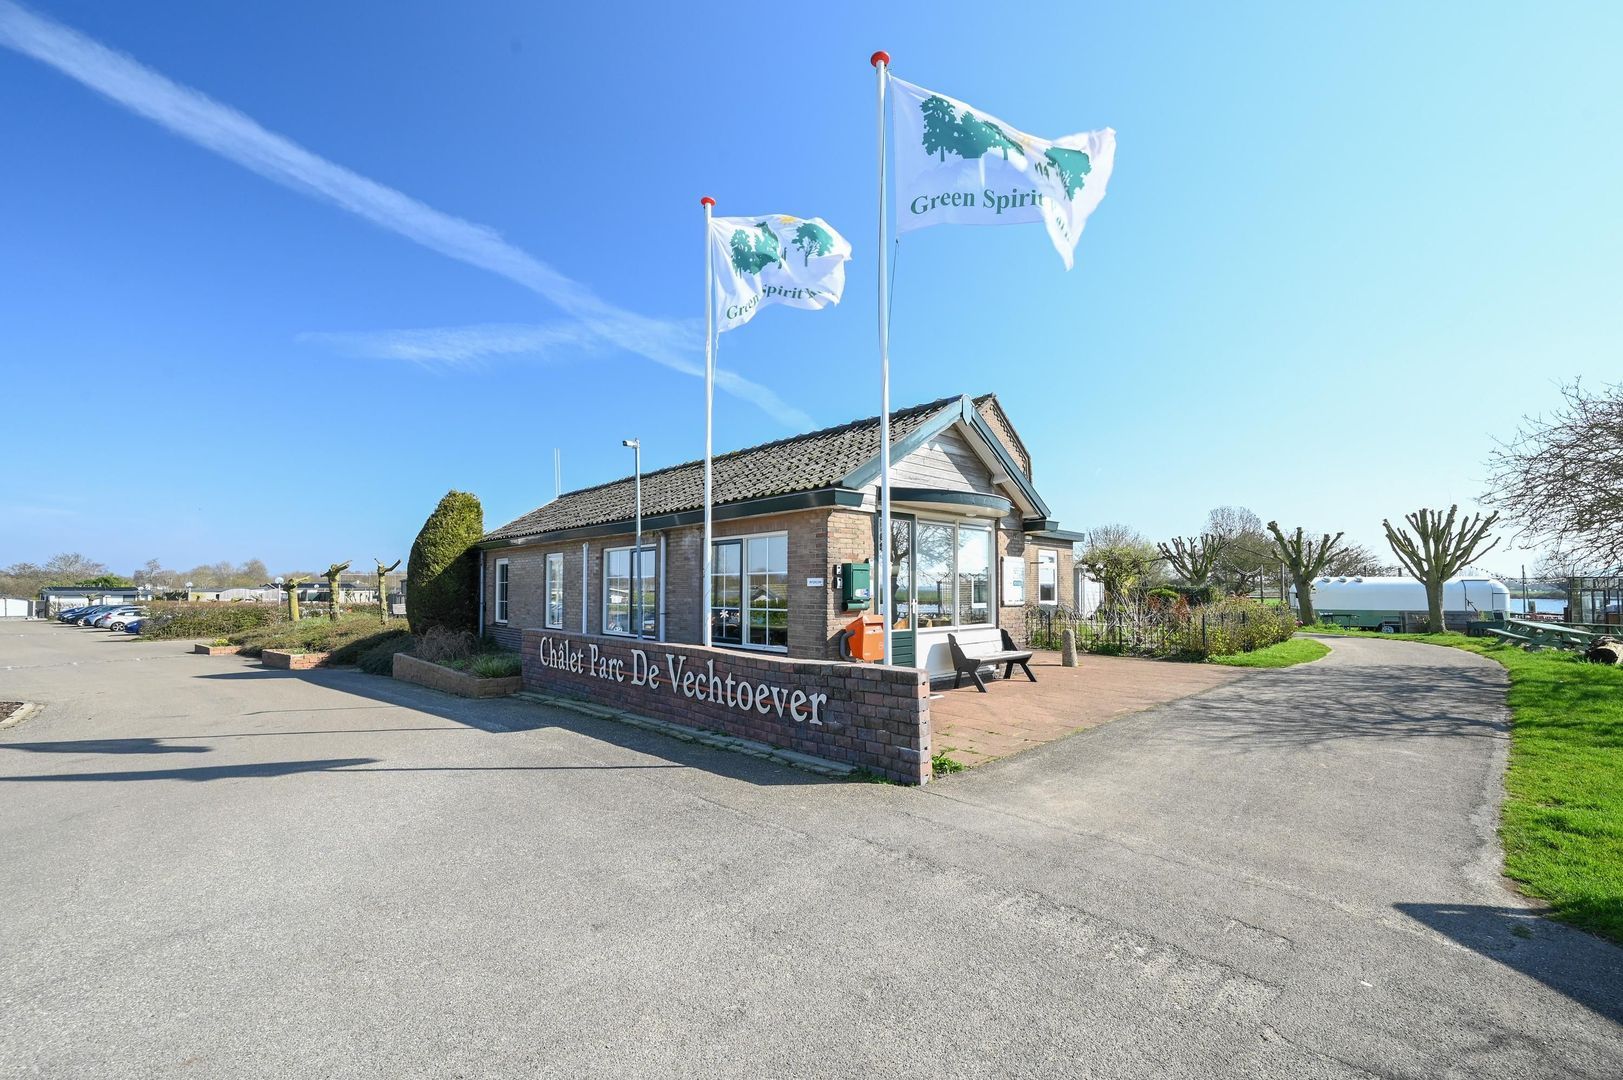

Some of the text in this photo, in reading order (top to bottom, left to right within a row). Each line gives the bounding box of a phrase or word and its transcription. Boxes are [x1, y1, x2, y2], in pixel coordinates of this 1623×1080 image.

[910, 188, 1044, 215] Green Spirit
[539, 636, 828, 726] Châlet Parc De Vechtoever
